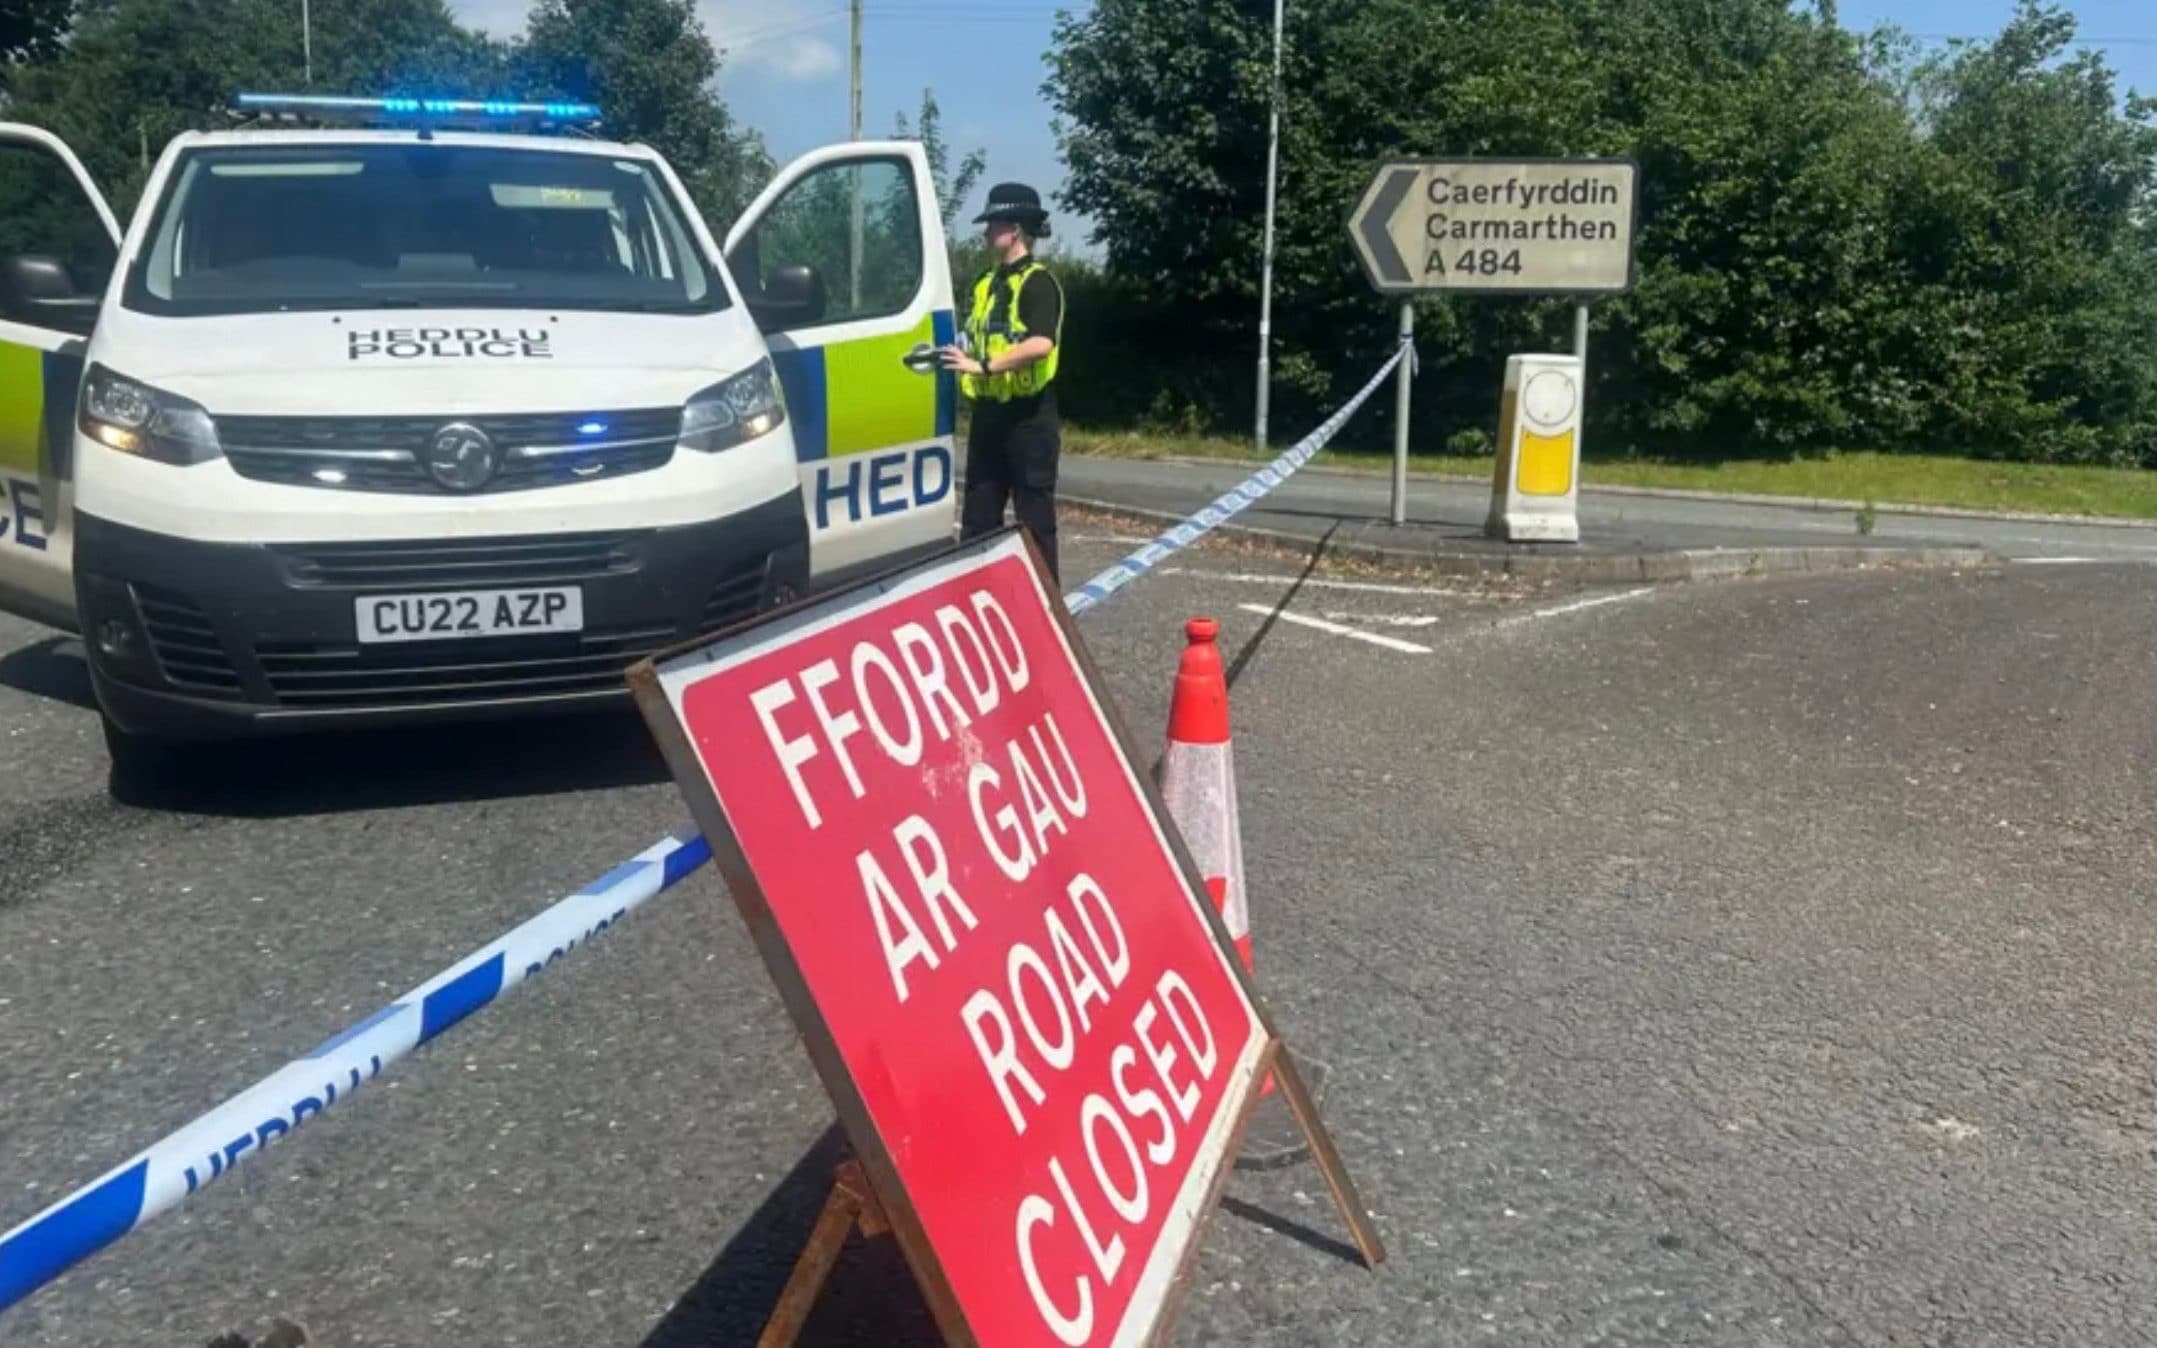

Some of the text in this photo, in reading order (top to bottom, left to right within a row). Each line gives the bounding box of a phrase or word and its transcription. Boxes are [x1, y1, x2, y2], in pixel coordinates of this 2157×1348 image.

[1427, 178, 1618, 209] Caerfyrddin
[1426, 213, 1616, 239] Carmarthen
[1424, 249, 1522, 275] A 484
[348, 328, 549, 344] HEDDLU
[348, 341, 553, 360] POLICE
[816, 446, 951, 529] HED
[373, 592, 567, 635] CU22 AZP
[749, 588, 1032, 830] FFORDD
[854, 712, 1088, 1004] AR GAU
[959, 872, 1132, 1135] ROAD
[1014, 968, 1218, 1348] CLOSED
